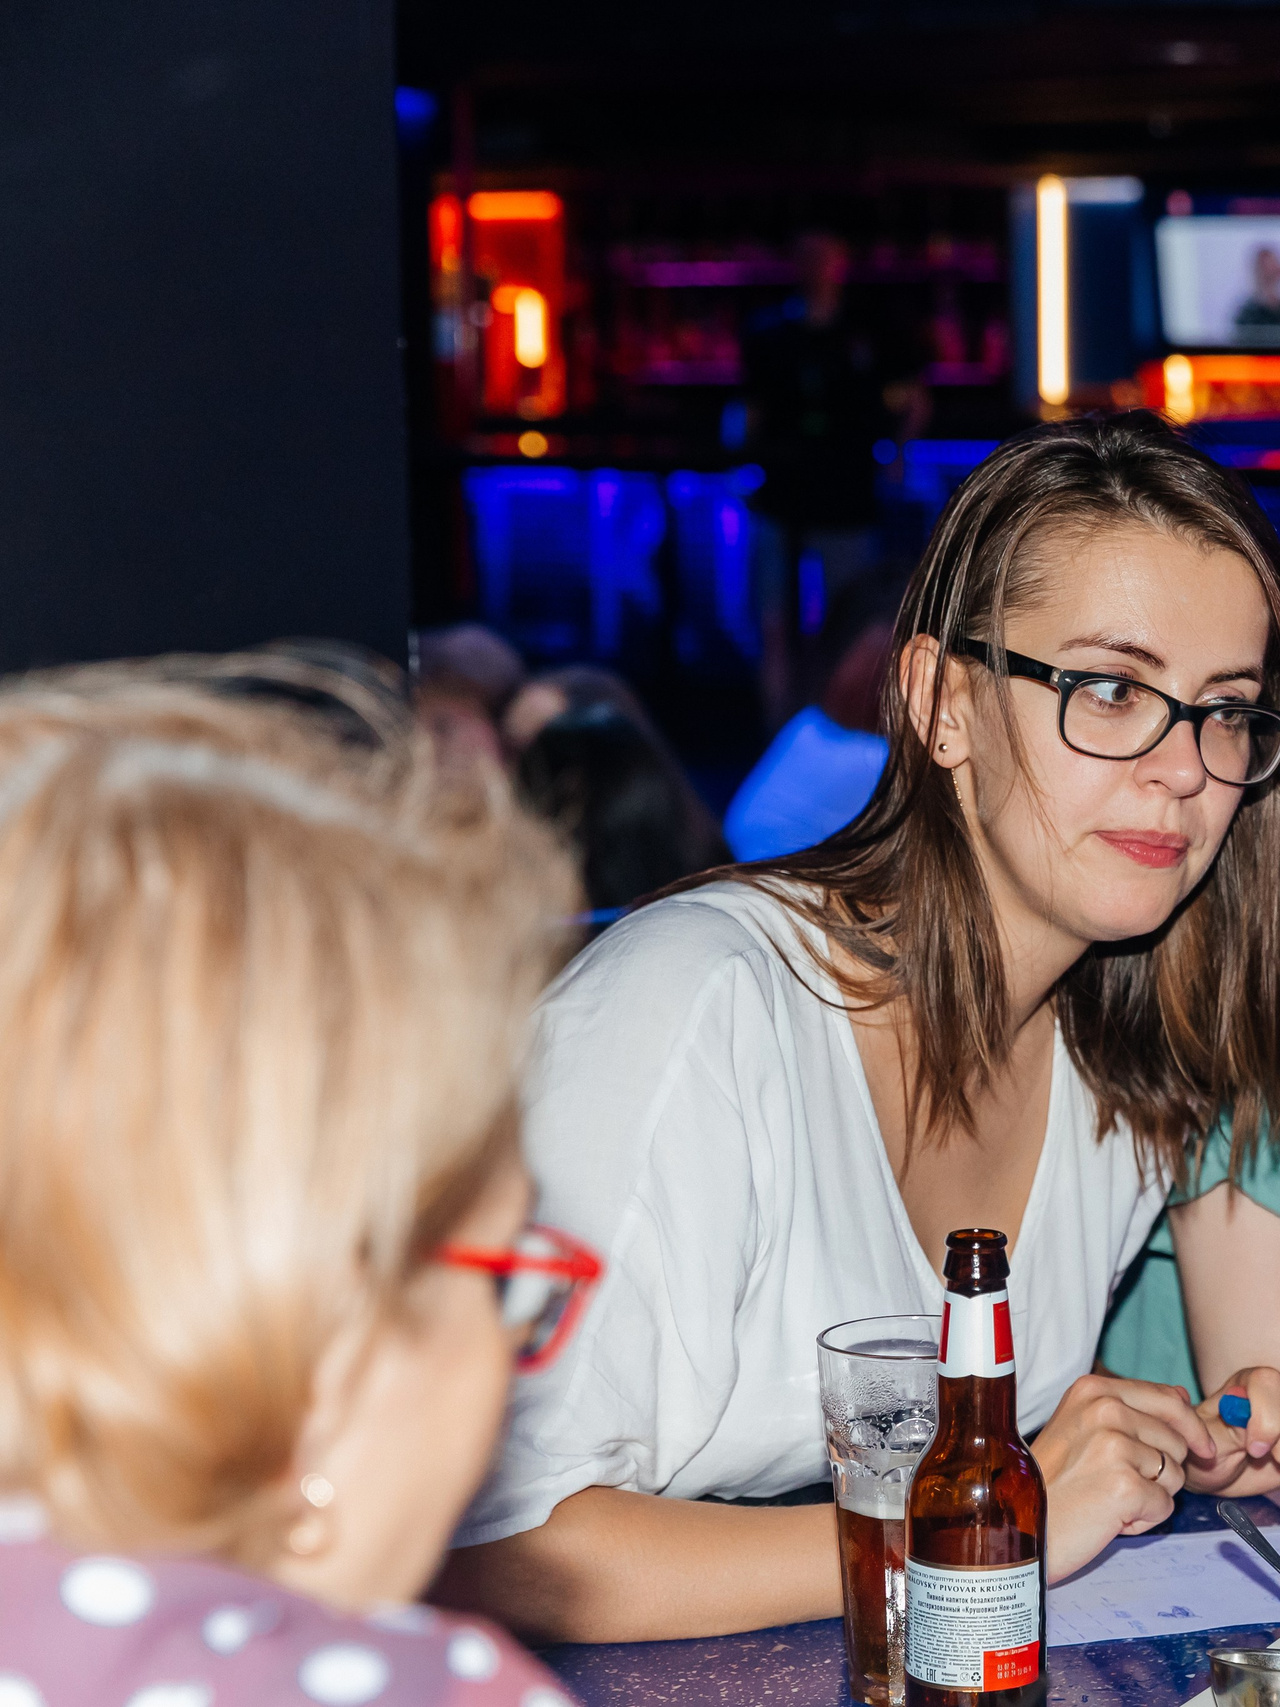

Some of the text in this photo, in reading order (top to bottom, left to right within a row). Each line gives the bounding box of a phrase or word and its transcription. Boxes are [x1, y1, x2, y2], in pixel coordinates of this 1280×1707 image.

[975, 1576, 1008, 1584] КОНТРОЛЕМ
[939, 1584, 976, 1593] PIVOVAR
[980, 1581, 1026, 1593] KRUŠOVICE
[926, 1592, 944, 1602] Пивной
[970, 1593, 1017, 1604] безалкогольный
[917, 1600, 961, 1613] пастеризованный
